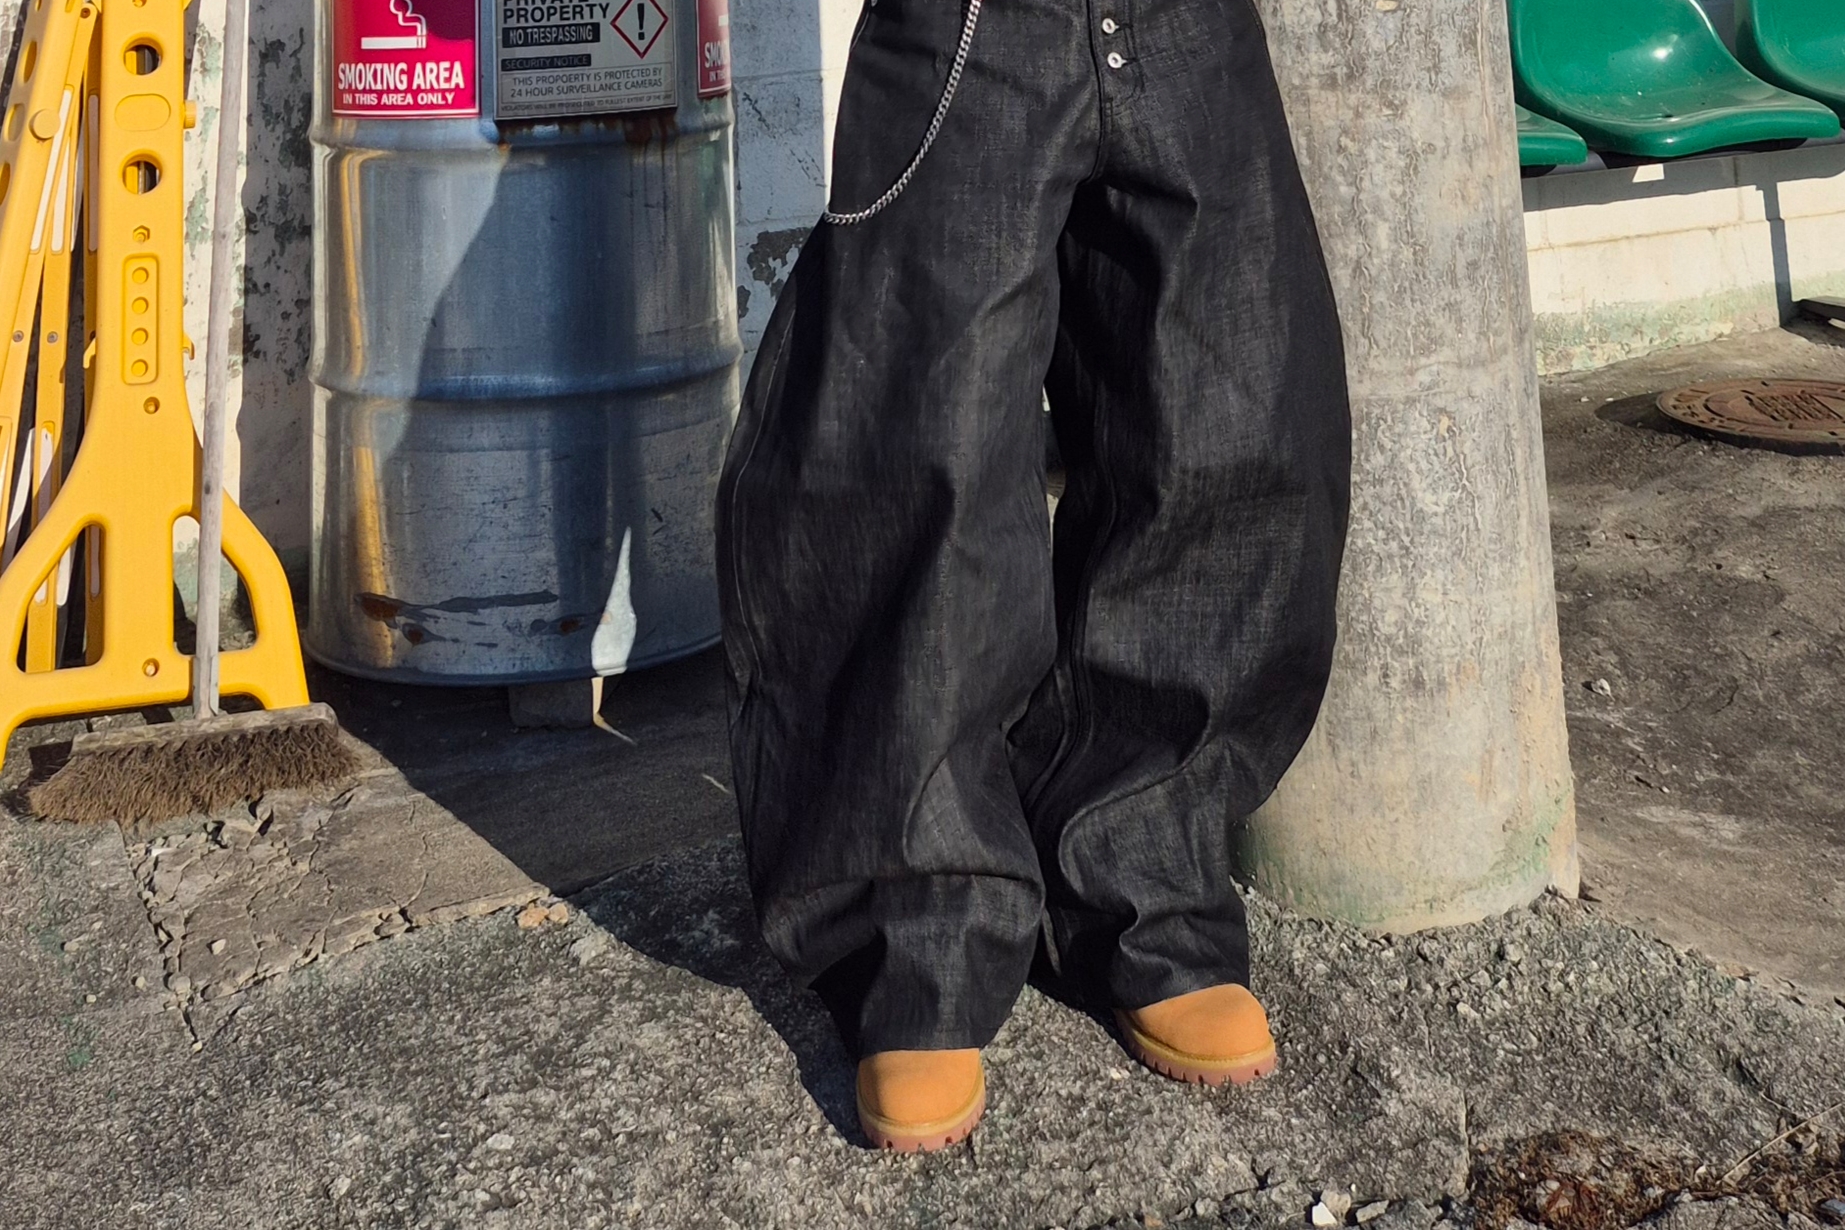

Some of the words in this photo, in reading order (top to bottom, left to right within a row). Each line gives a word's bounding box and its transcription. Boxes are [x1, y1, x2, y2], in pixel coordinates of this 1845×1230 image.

[503, 2, 610, 24] PROPERTY
[509, 30, 524, 45] NO
[527, 29, 593, 43] TRESPASSING
[505, 58, 551, 70] SECURITY
[554, 56, 588, 66] NOTICE
[338, 62, 408, 91] SMOKING
[412, 61, 465, 91] AREA
[513, 76, 533, 86] THIS
[536, 73, 591, 85] PROPOERTY
[594, 72, 602, 82] IS
[604, 67, 651, 81] PROTECTED
[652, 66, 663, 77] BY
[511, 88, 522, 98] 24
[526, 86, 554, 97] HOUR
[556, 81, 622, 96] SURVEILLANCE
[625, 78, 663, 90] CAMERAS
[343, 94, 352, 105] IN
[355, 93, 378, 105] THIS
[381, 93, 413, 105] AREA
[417, 92, 455, 105] ONLY
